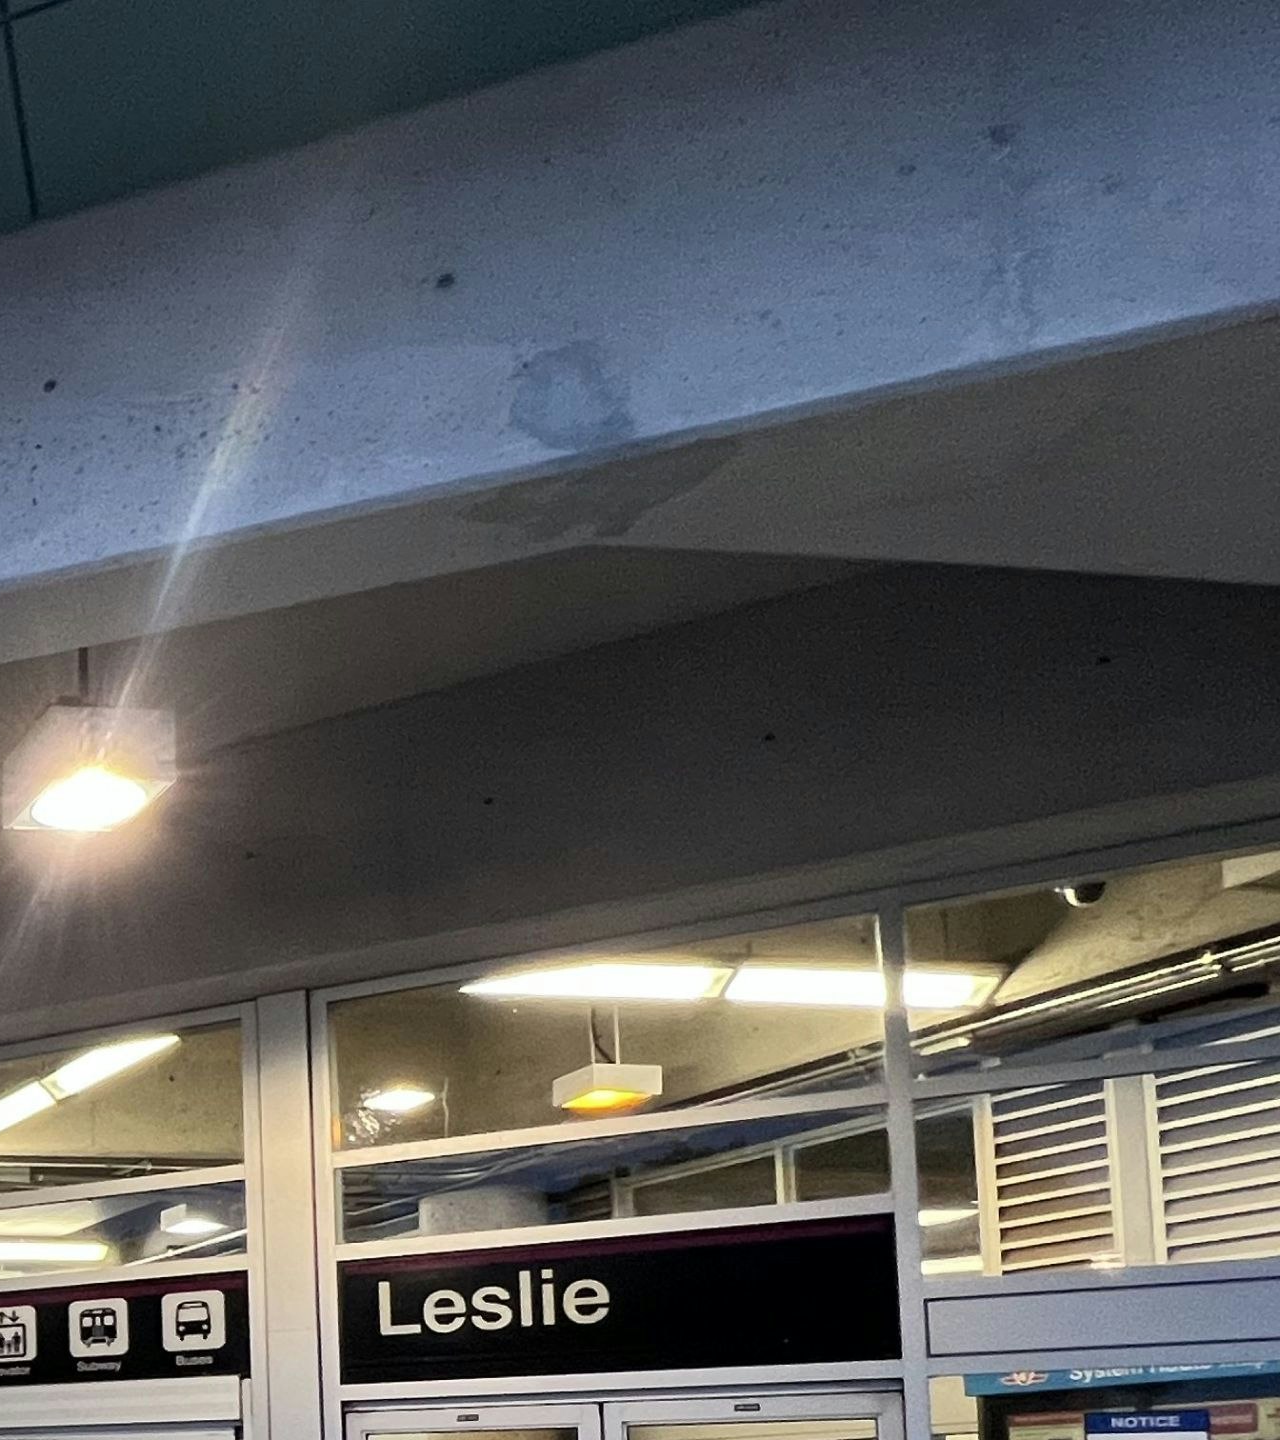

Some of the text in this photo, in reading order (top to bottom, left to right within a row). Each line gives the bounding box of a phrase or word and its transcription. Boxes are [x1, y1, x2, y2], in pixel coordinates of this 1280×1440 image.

[378, 1269, 610, 1336] Leslie
[77, 1360, 122, 1372] Subway
[1110, 1415, 1180, 1429] NOTICE
